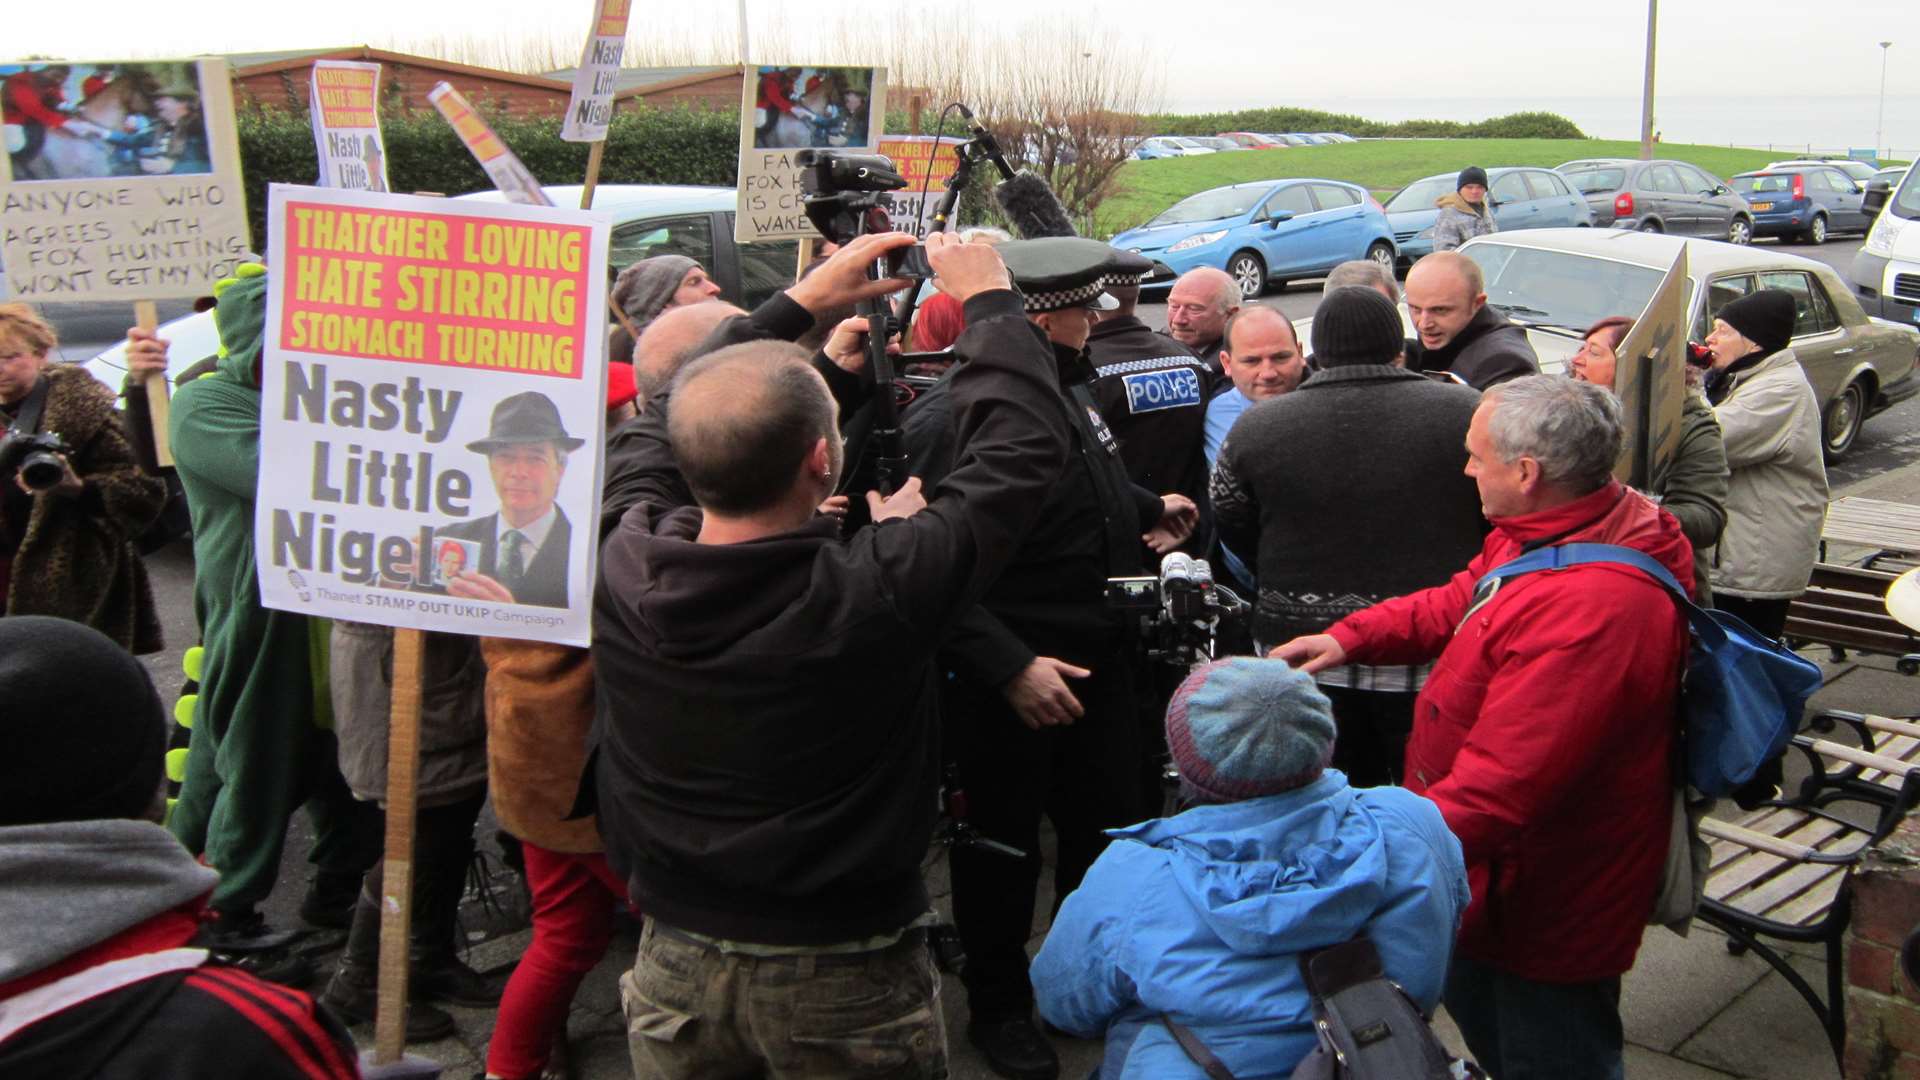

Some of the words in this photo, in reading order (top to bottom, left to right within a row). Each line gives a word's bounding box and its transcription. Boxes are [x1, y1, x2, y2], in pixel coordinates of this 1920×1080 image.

[746, 174, 783, 191] FOX
[4, 188, 133, 214] ANYONE
[155, 185, 224, 206] WHO
[746, 195, 766, 211] IS
[889, 196, 920, 218] asty
[4, 221, 112, 244] AGREES
[131, 217, 202, 237] WITH
[294, 207, 449, 262] THATCHER
[464, 222, 582, 273] LOVING
[752, 214, 810, 233] WAKE
[29, 247, 87, 268] FOX
[107, 235, 246, 262] HUNTING
[12, 269, 93, 294] WONT
[106, 266, 152, 287] GET
[158, 265, 191, 285] MY
[296, 254, 383, 308] HATE
[397, 264, 577, 326] STIRRING
[290, 311, 425, 360] STOMACH
[438, 323, 574, 374] TURNING
[283, 360, 463, 443] Nasty
[1129, 374, 1199, 407] POLICE
[311, 440, 473, 517] Little
[272, 508, 436, 586] Nigel
[316, 587, 361, 604] Thanet
[365, 594, 415, 611] STAMP
[419, 601, 450, 616] OUT
[454, 604, 490, 619] UKIP
[493, 607, 565, 627] Campaign
